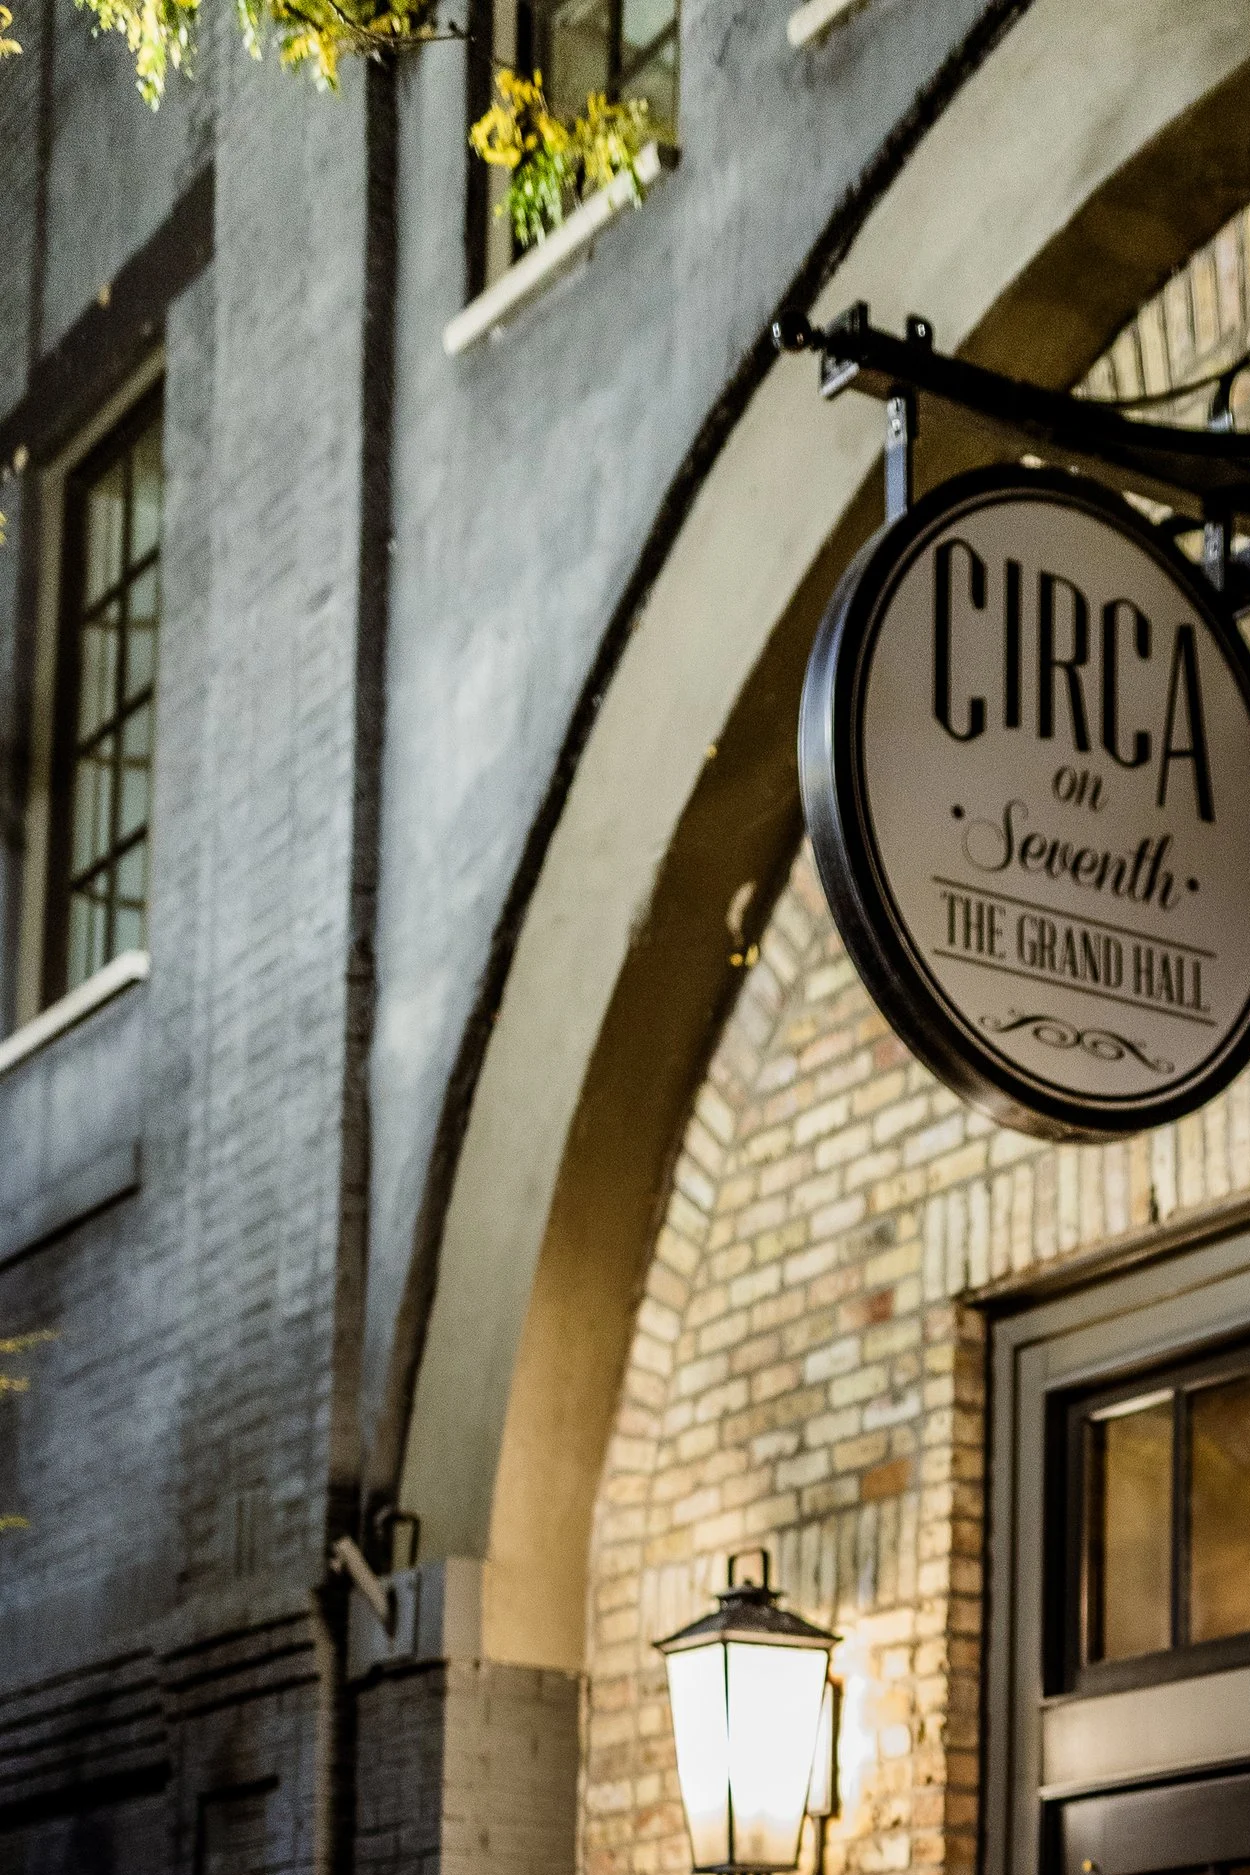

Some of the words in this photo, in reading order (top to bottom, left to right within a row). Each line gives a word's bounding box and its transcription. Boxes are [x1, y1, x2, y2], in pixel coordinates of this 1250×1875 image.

[934, 538, 1215, 822] CIRCA
[1052, 765, 1109, 813] on
[961, 800, 1183, 911] Seventh
[940, 891, 1006, 957] THE
[1017, 915, 1124, 989] GRAND
[1133, 945, 1211, 1012] HALL
